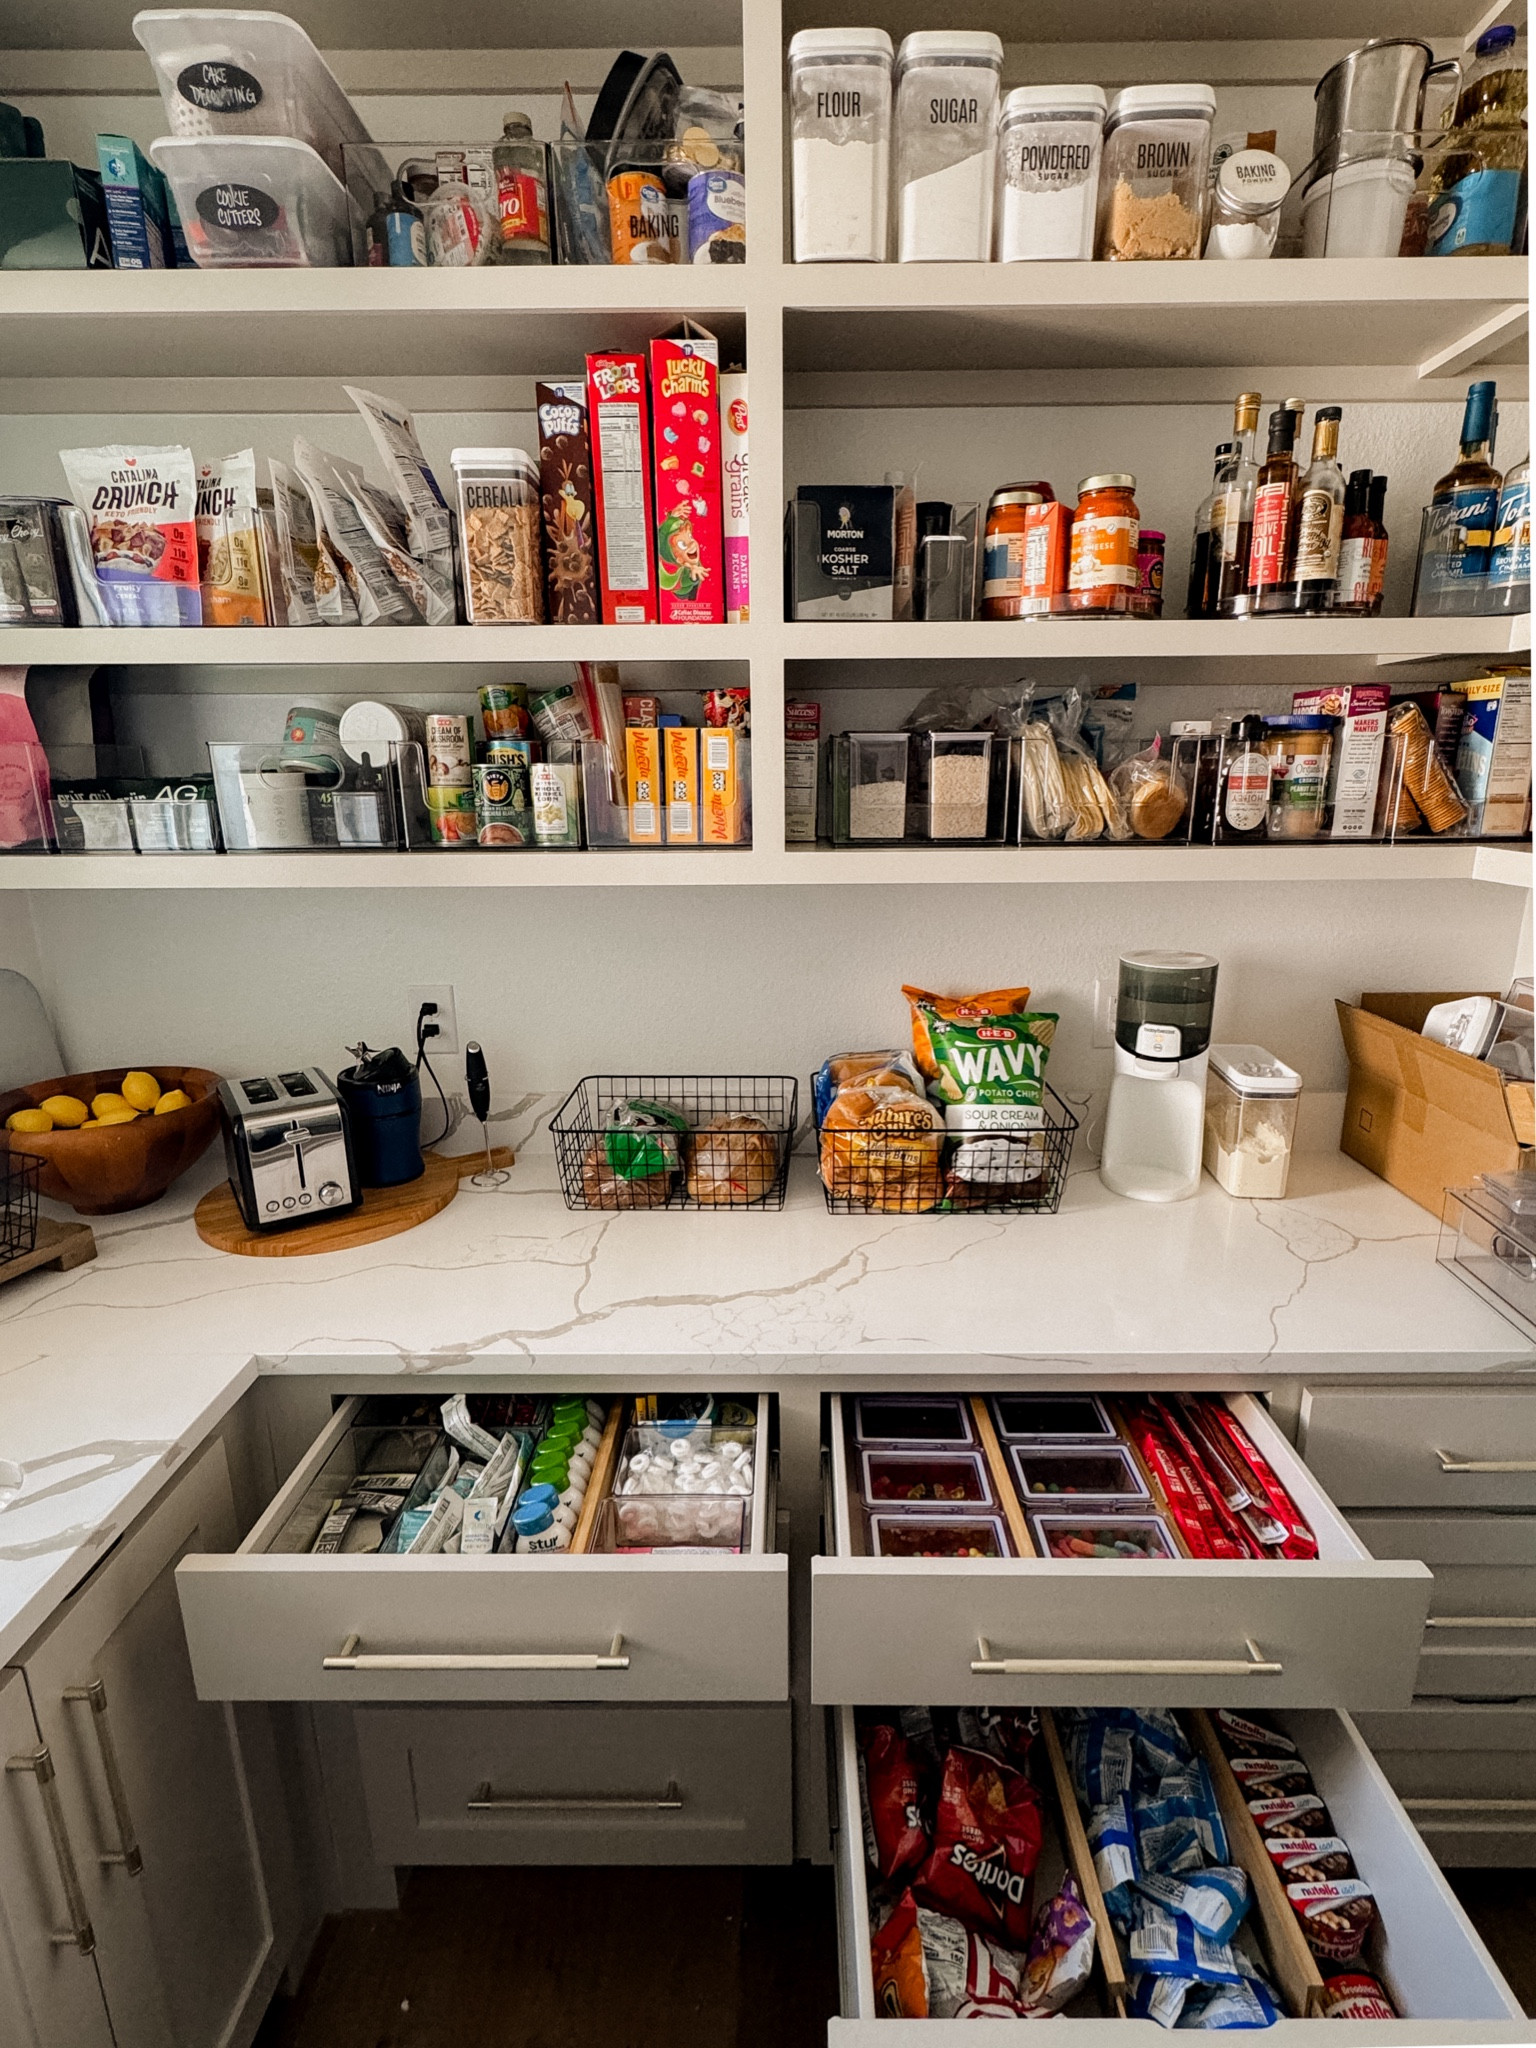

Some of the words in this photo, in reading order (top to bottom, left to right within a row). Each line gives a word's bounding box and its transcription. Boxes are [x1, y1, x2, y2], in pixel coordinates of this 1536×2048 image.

[202, 64, 227, 86] CAKE
[189, 84, 257, 107] DECORATING
[817, 91, 861, 118] FLOUR
[930, 98, 978, 124] SUGAR
[1020, 144, 1090, 172] POWDERED
[1137, 142, 1190, 169] BROWN
[1038, 172, 1069, 181] SUGAR
[1147, 169, 1179, 178] SUGAR
[1236, 164, 1276, 179] BAKING
[216, 184, 249, 208] COOKIE
[217, 207, 262, 226] CUTTERS
[630, 215, 679, 239] BAKING
[592, 362, 637, 388] FROOT
[666, 358, 706, 380] Lucky
[598, 378, 641, 401] LOOPS
[661, 376, 710, 398] Charms
[539, 403, 580, 421] Cocoa
[732, 403, 747, 430] Post
[541, 418, 580, 439] Puffs
[111, 468, 158, 484] CATALINA
[92, 480, 179, 511] CRUNCH
[466, 486, 517, 509] CEREAL
[725, 460, 744, 519] grains
[105, 510, 126, 518] KETO
[127, 507, 158, 517] FRIENDLY
[827, 530, 864, 539] MORTON
[1253, 536, 1276, 558] OIL
[821, 554, 869, 564] KOSHER
[831, 565, 859, 575] SALT
[1483, 683, 1501, 692] SIZE
[786, 706, 816, 717] Success
[453, 726, 462, 735] OF
[1353, 725, 1378, 733] WANTED
[1354, 718, 1379, 726] MAKERS
[487, 753, 525, 765] BUSH'S
[950, 1043, 1044, 1085] WAVY
[979, 1089, 1014, 1097] POTATO
[1015, 1089, 1040, 1099] CHIPS
[965, 1109, 998, 1120] SOUR
[1000, 1110, 1039, 1121] CREAM
[978, 1120, 987, 1130] &
[991, 1121, 1029, 1130] ONION
[529, 1535, 559, 1551] stur
[1244, 1760, 1279, 1771] nutella
[1260, 1799, 1295, 1811] nutella
[1280, 1839, 1317, 1850] nutella
[950, 1843, 1026, 1905] Doritos
[1301, 1884, 1340, 1896] nutella
